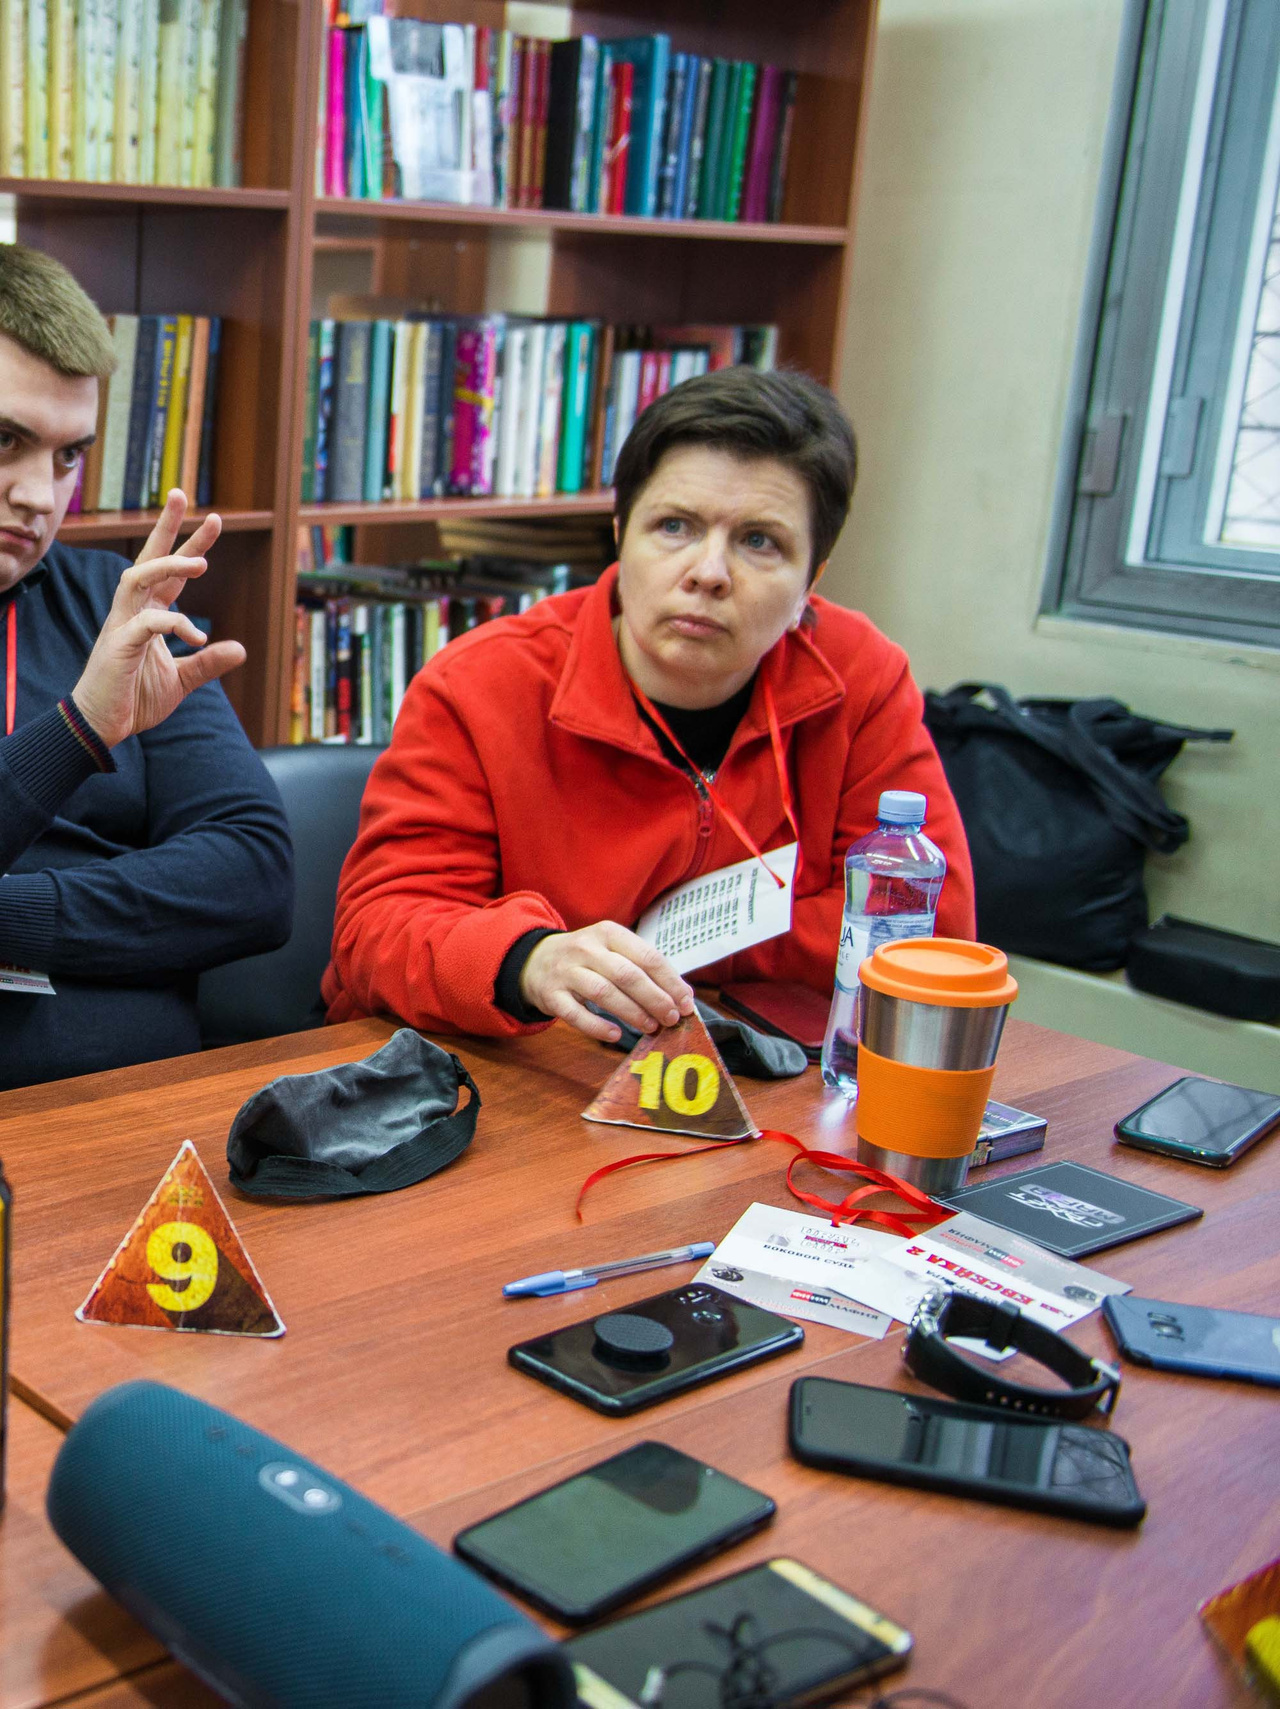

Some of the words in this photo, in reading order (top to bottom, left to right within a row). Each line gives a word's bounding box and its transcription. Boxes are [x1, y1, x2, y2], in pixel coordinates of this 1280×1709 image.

[630, 1051, 720, 1116] 10
[948, 1229, 990, 1248] МАФИЯ
[145, 1221, 218, 1312] 9
[763, 1244, 820, 1261] БОКОВОЙ
[824, 1259, 855, 1269] СУДЬ
[828, 1302, 879, 1321] МАФИЯ
